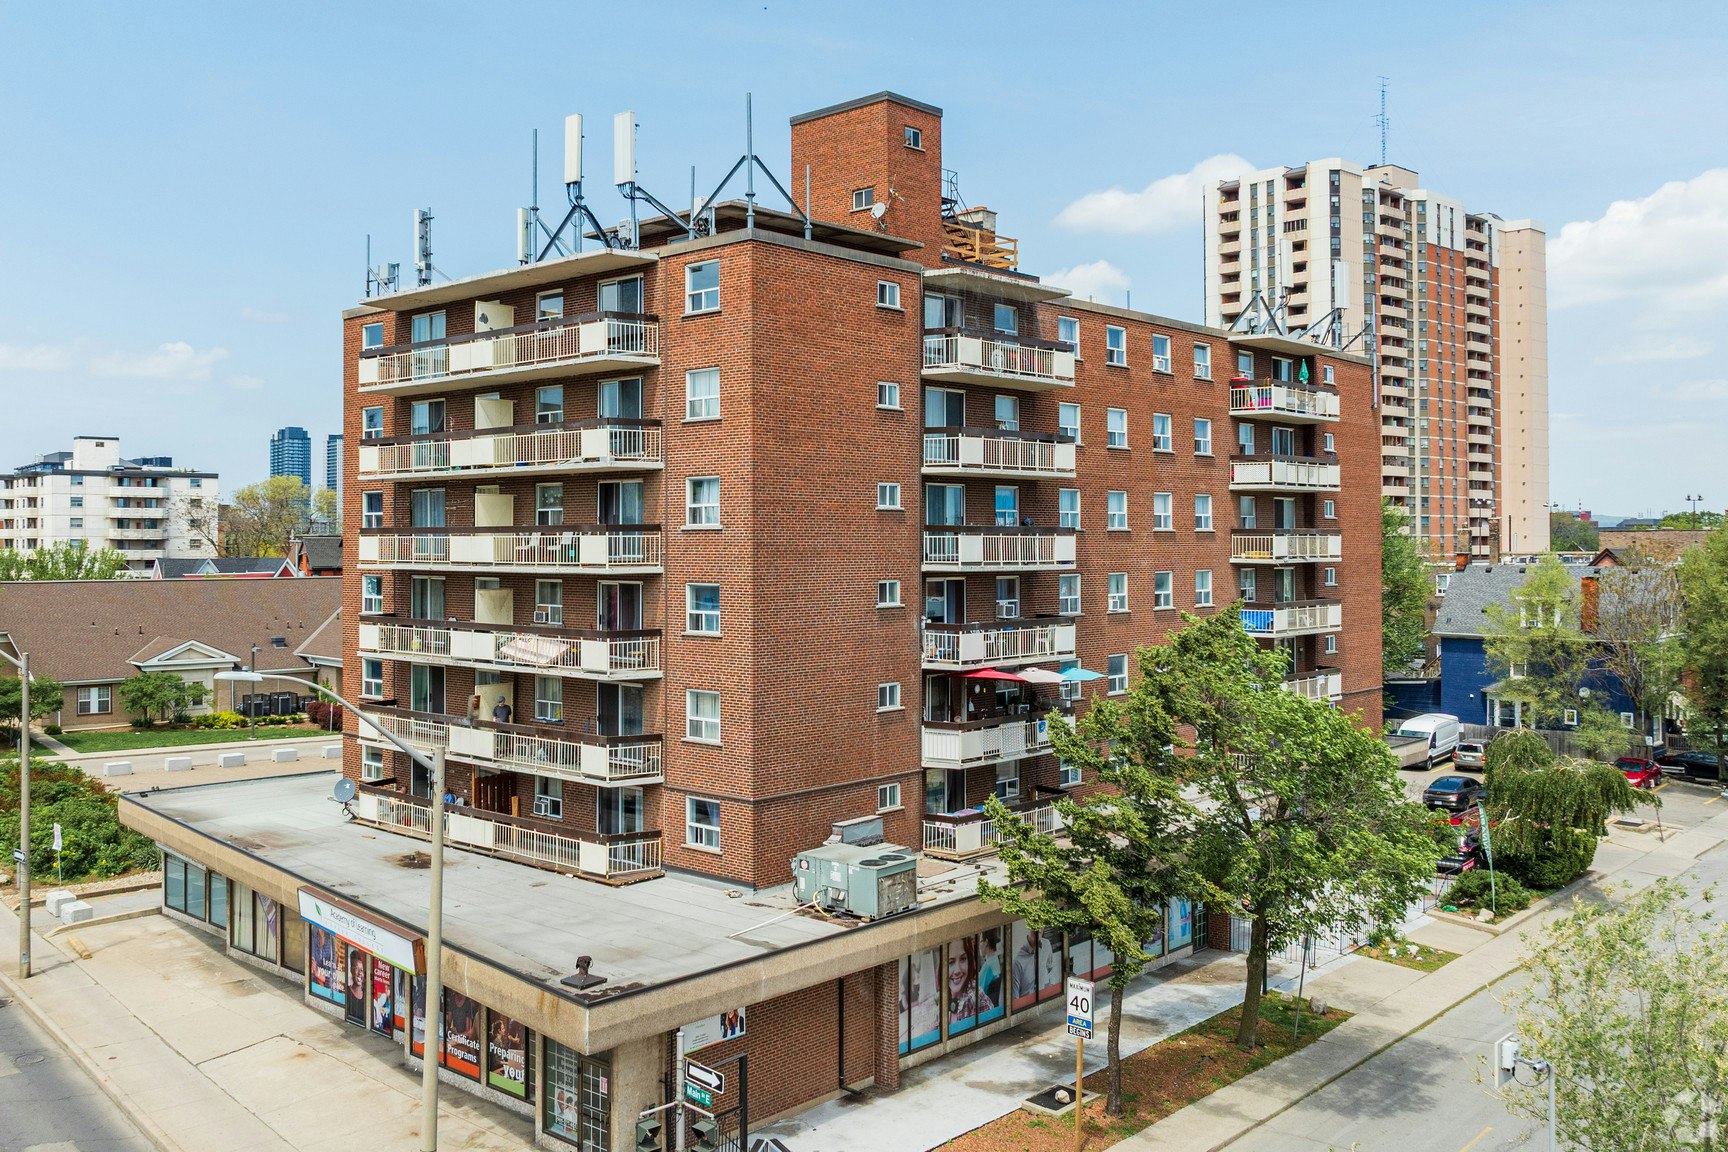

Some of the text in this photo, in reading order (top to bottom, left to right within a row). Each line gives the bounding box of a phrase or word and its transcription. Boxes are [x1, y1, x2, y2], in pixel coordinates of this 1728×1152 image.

[330, 908, 350, 928] Academy
[356, 920, 377, 941] Learning
[318, 966, 331, 978] your
[374, 968, 391, 979] career
[378, 960, 390, 972] New
[1070, 995, 1090, 1014] 40
[1072, 1018, 1087, 1028] AREA
[447, 1030, 480, 1050] Certificate
[1069, 1026, 1091, 1039] BEGINS
[447, 1043, 477, 1063] Programs
[687, 1085, 701, 1100] Main
[705, 1094, 710, 1104] E
